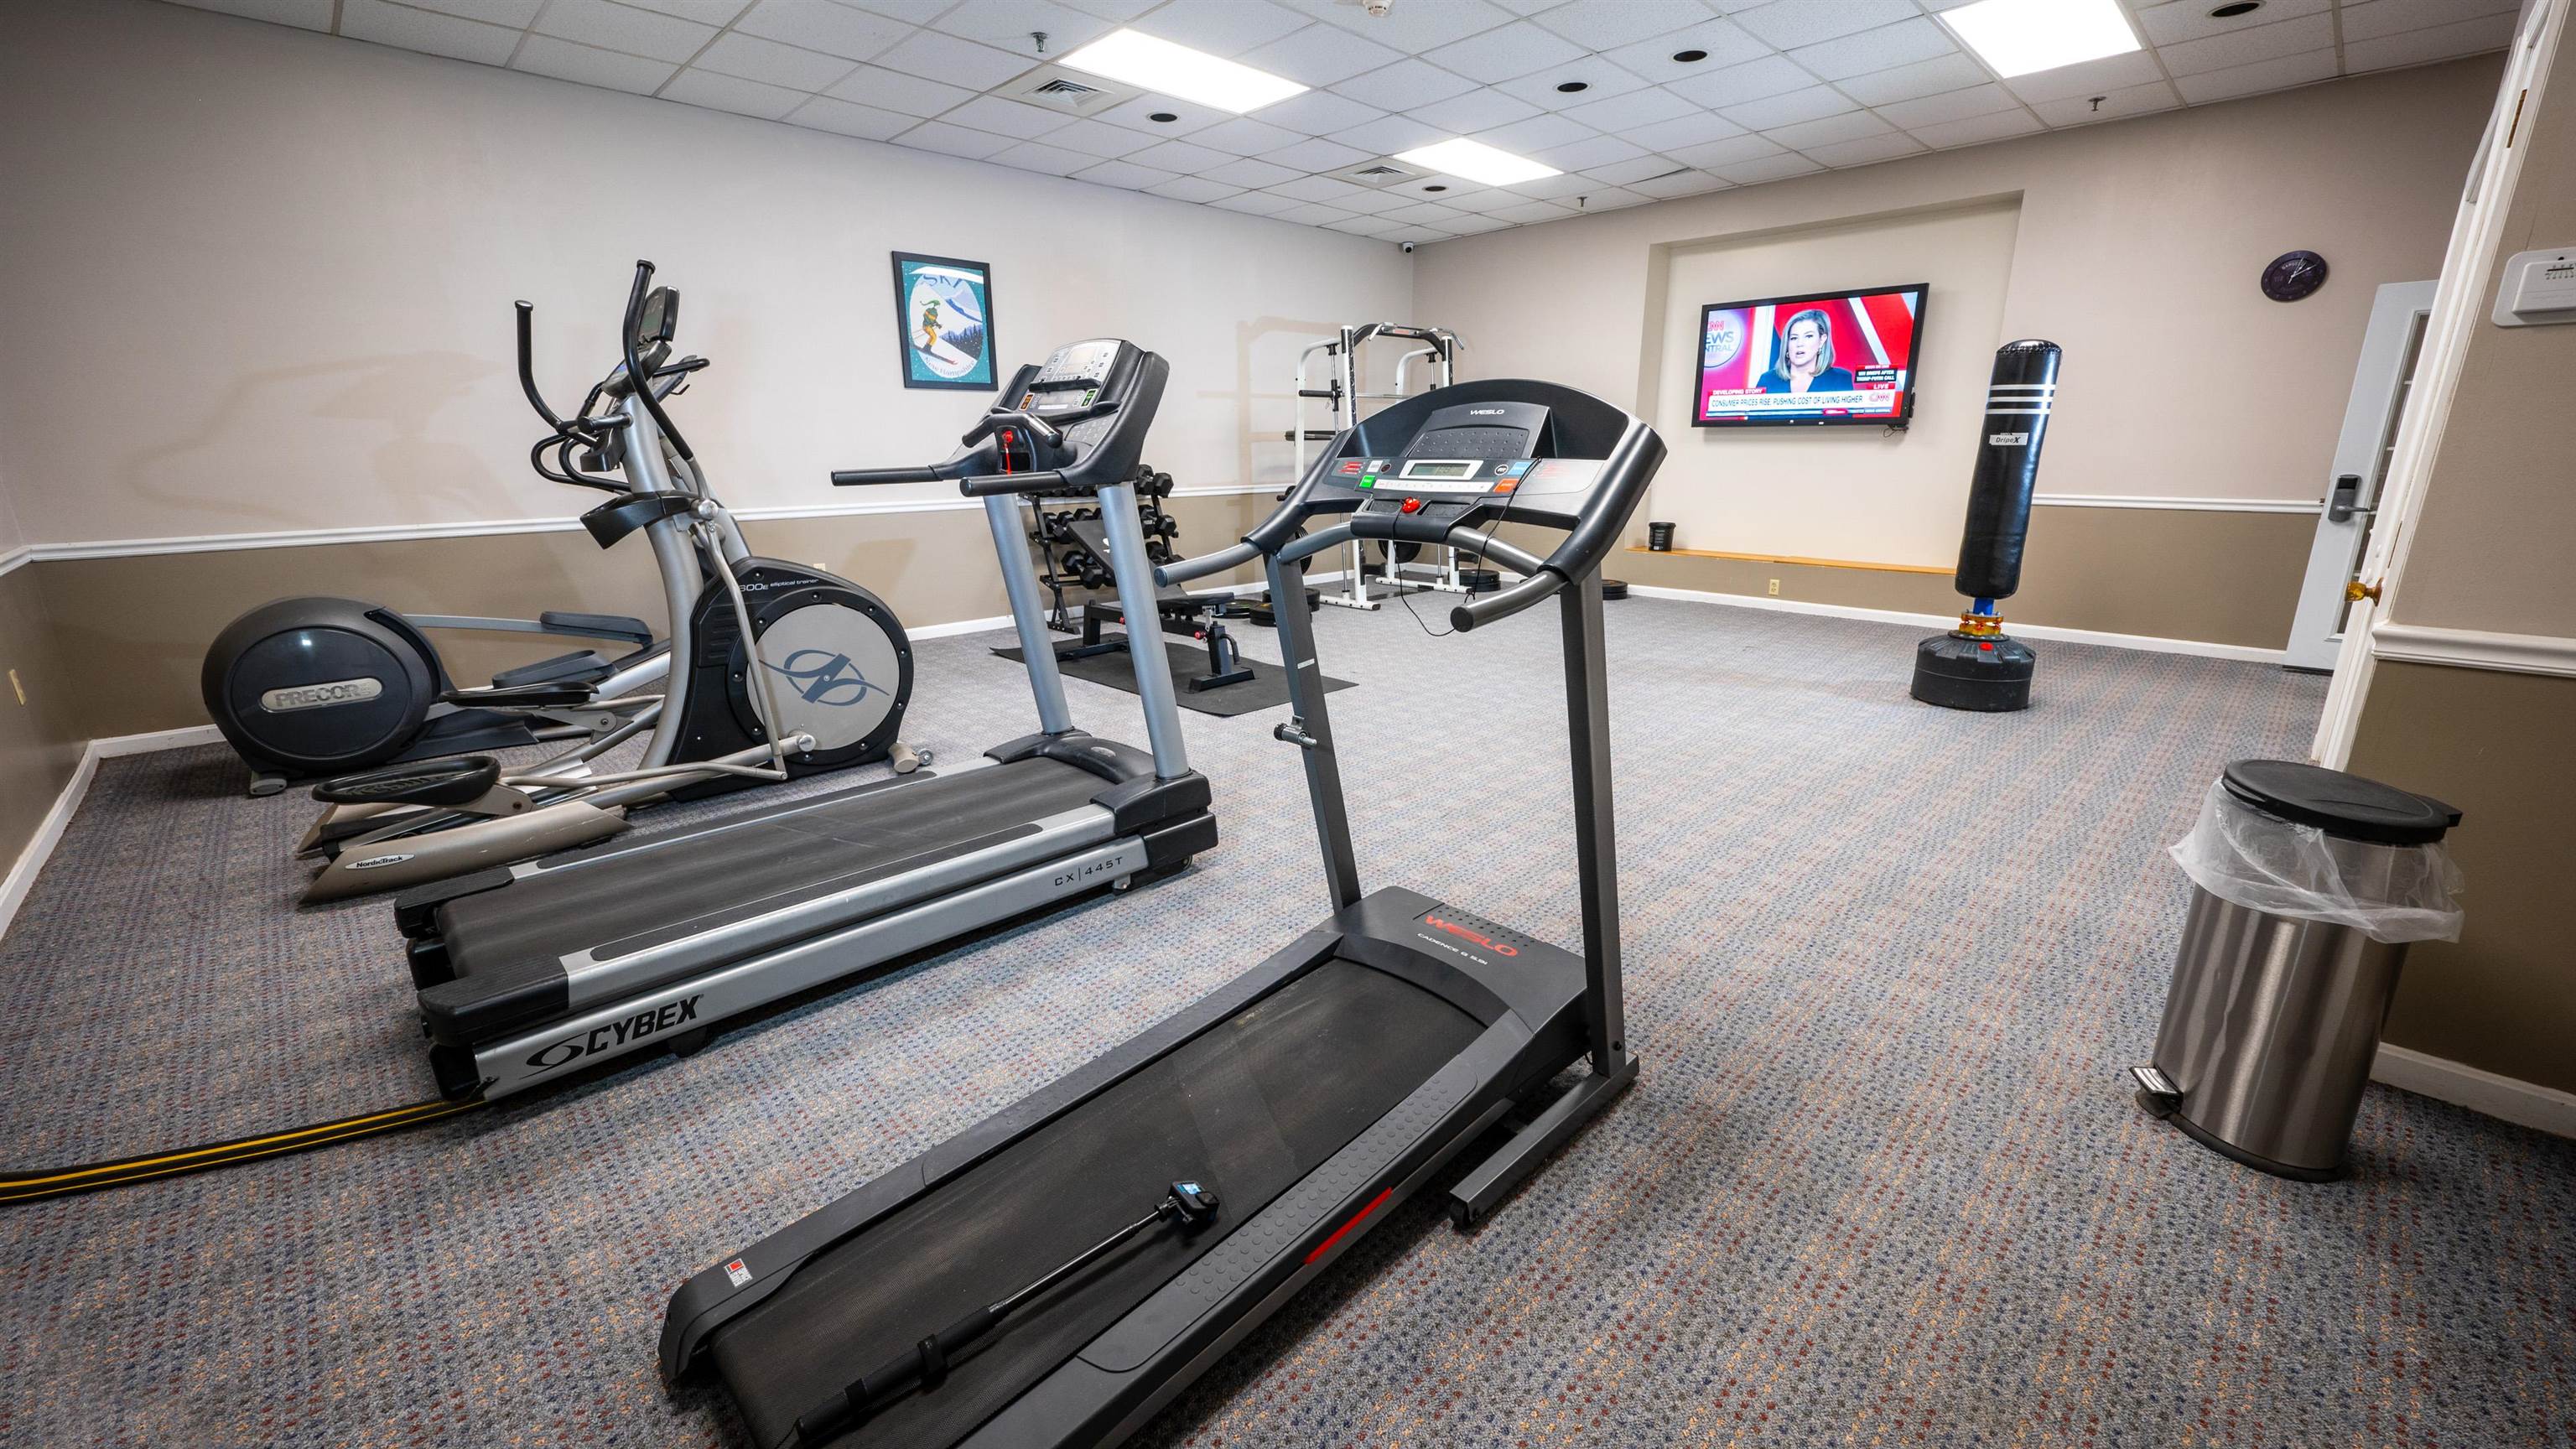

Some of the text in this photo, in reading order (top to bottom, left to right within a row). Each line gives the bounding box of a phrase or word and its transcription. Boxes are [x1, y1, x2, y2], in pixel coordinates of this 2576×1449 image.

[1711, 398, 1739, 408] CONSUMER
[1740, 397, 1758, 407] PRICES
[1774, 397, 1796, 406] PUSHING
[1798, 396, 1812, 405] COST
[1813, 396, 1821, 404] OF
[1822, 395, 1840, 404] LIVING
[1841, 395, 1863, 403] HIGHER
[1869, 392, 1890, 402] CNN
[274, 684, 361, 707] PRECOR
[356, 855, 403, 868] NordicTrack
[1417, 932, 1459, 953] CADENCE
[1426, 915, 1518, 957] WESLO
[585, 994, 701, 1057] CYBEX
